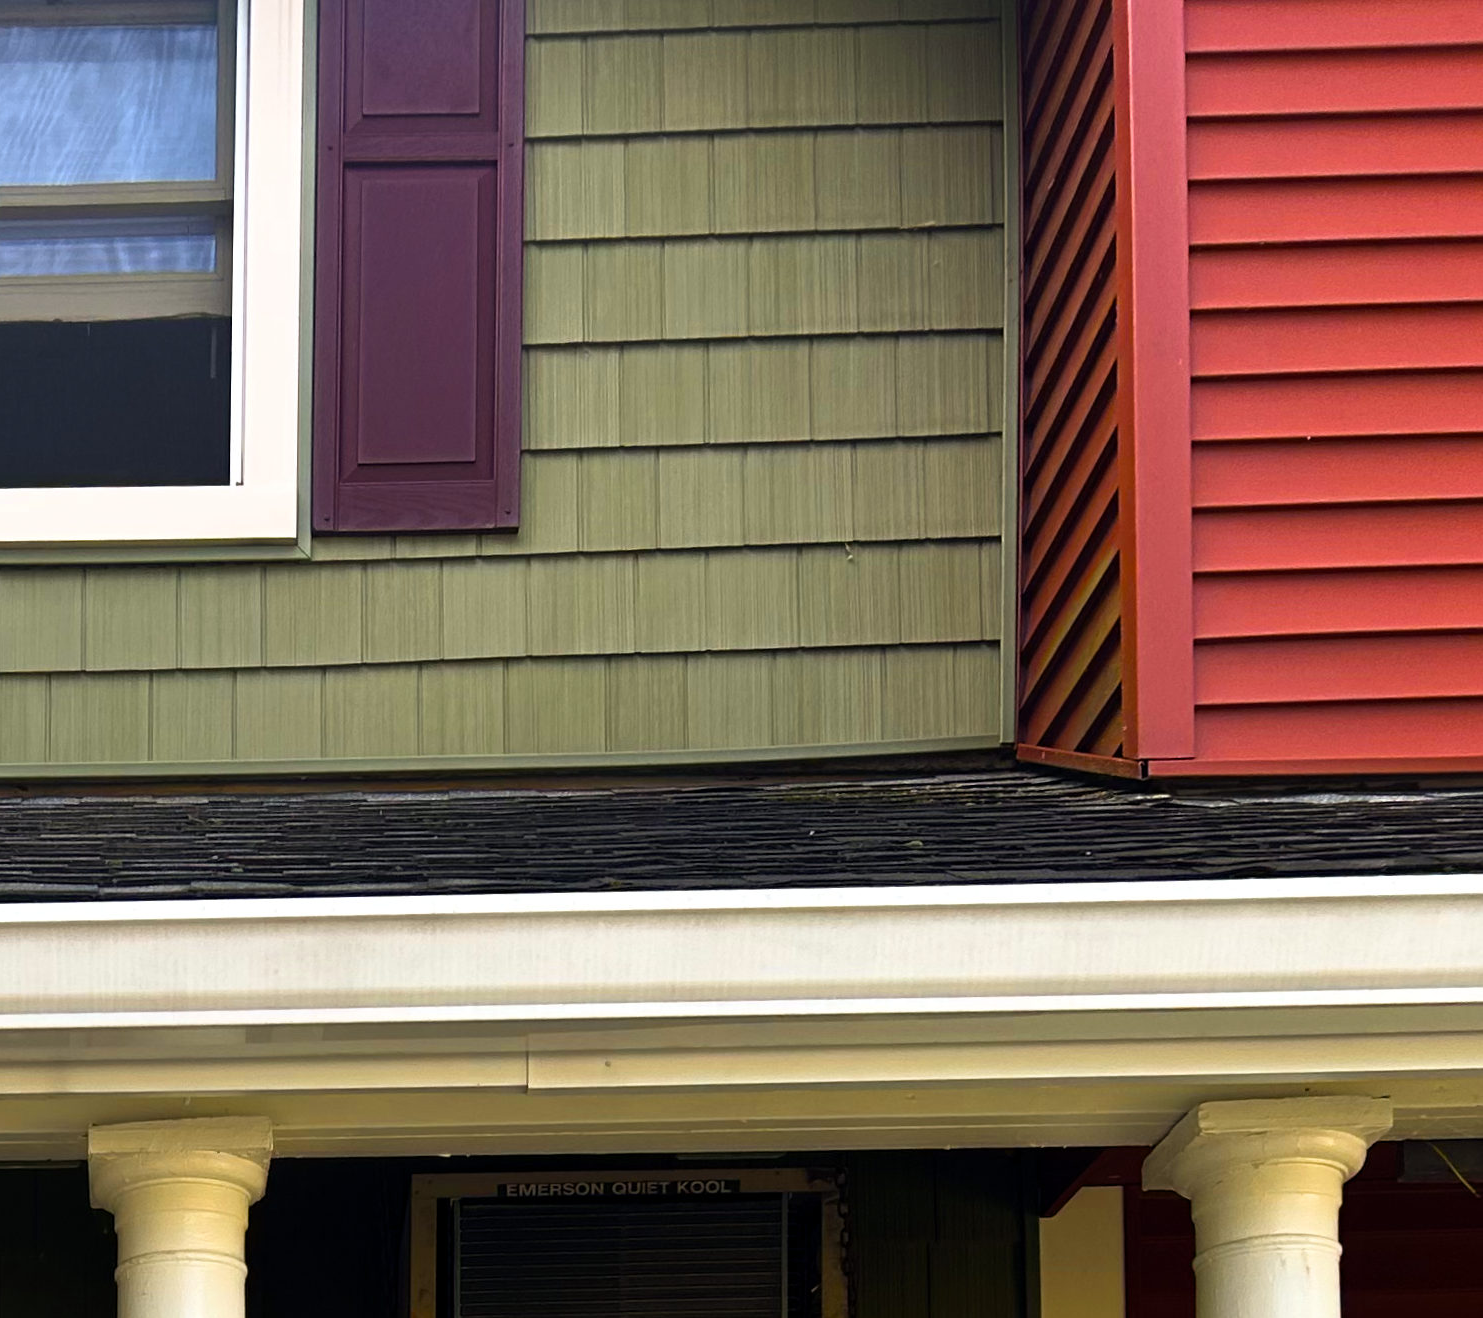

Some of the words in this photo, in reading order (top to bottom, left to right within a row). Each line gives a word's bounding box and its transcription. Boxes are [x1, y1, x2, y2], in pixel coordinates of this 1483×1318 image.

[506, 1182, 604, 1197] EMERSON
[611, 1181, 668, 1196] QUIET
[676, 1180, 731, 1194] KOOL
